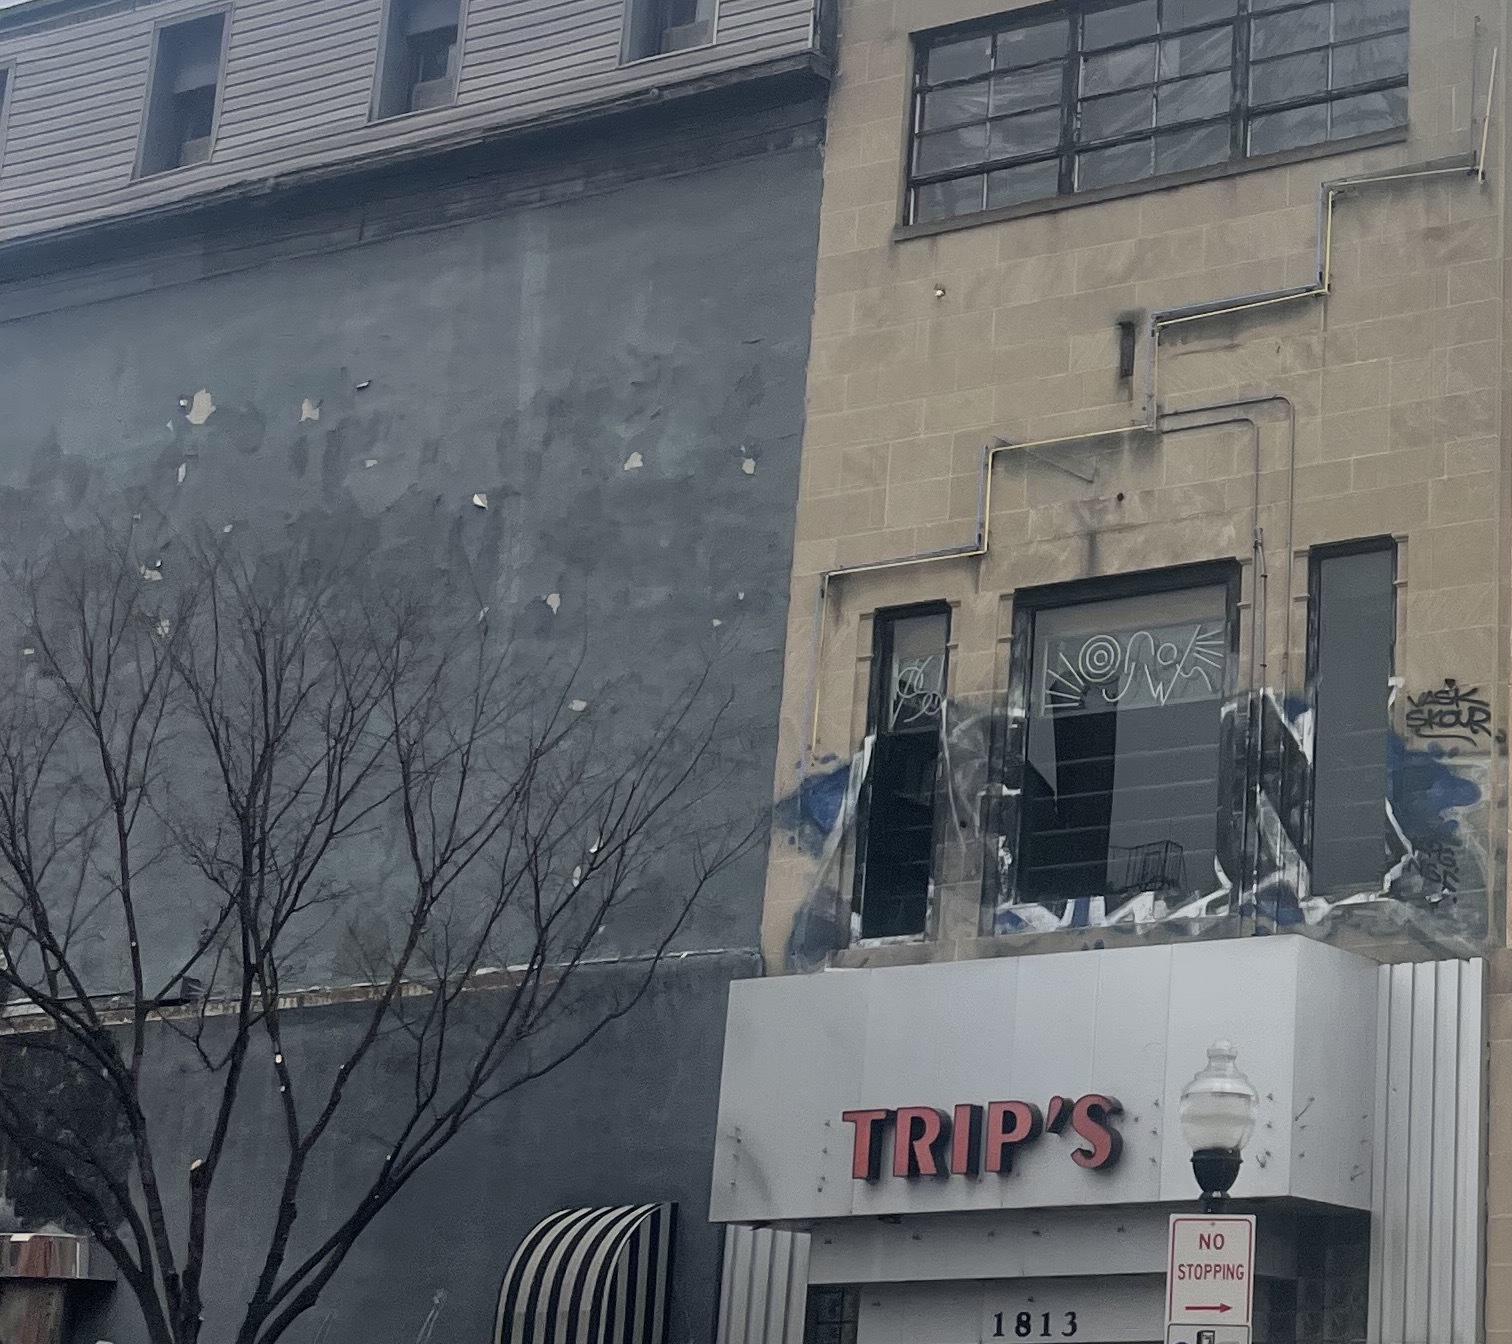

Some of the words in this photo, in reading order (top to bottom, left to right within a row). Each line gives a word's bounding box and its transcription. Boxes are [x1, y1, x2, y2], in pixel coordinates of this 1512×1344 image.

[842, 1093, 1123, 1185] TRIP'S
[1199, 1233, 1225, 1250] NO
[1177, 1263, 1245, 1280] STOPPING
[993, 1311, 1077, 1337] 1813
